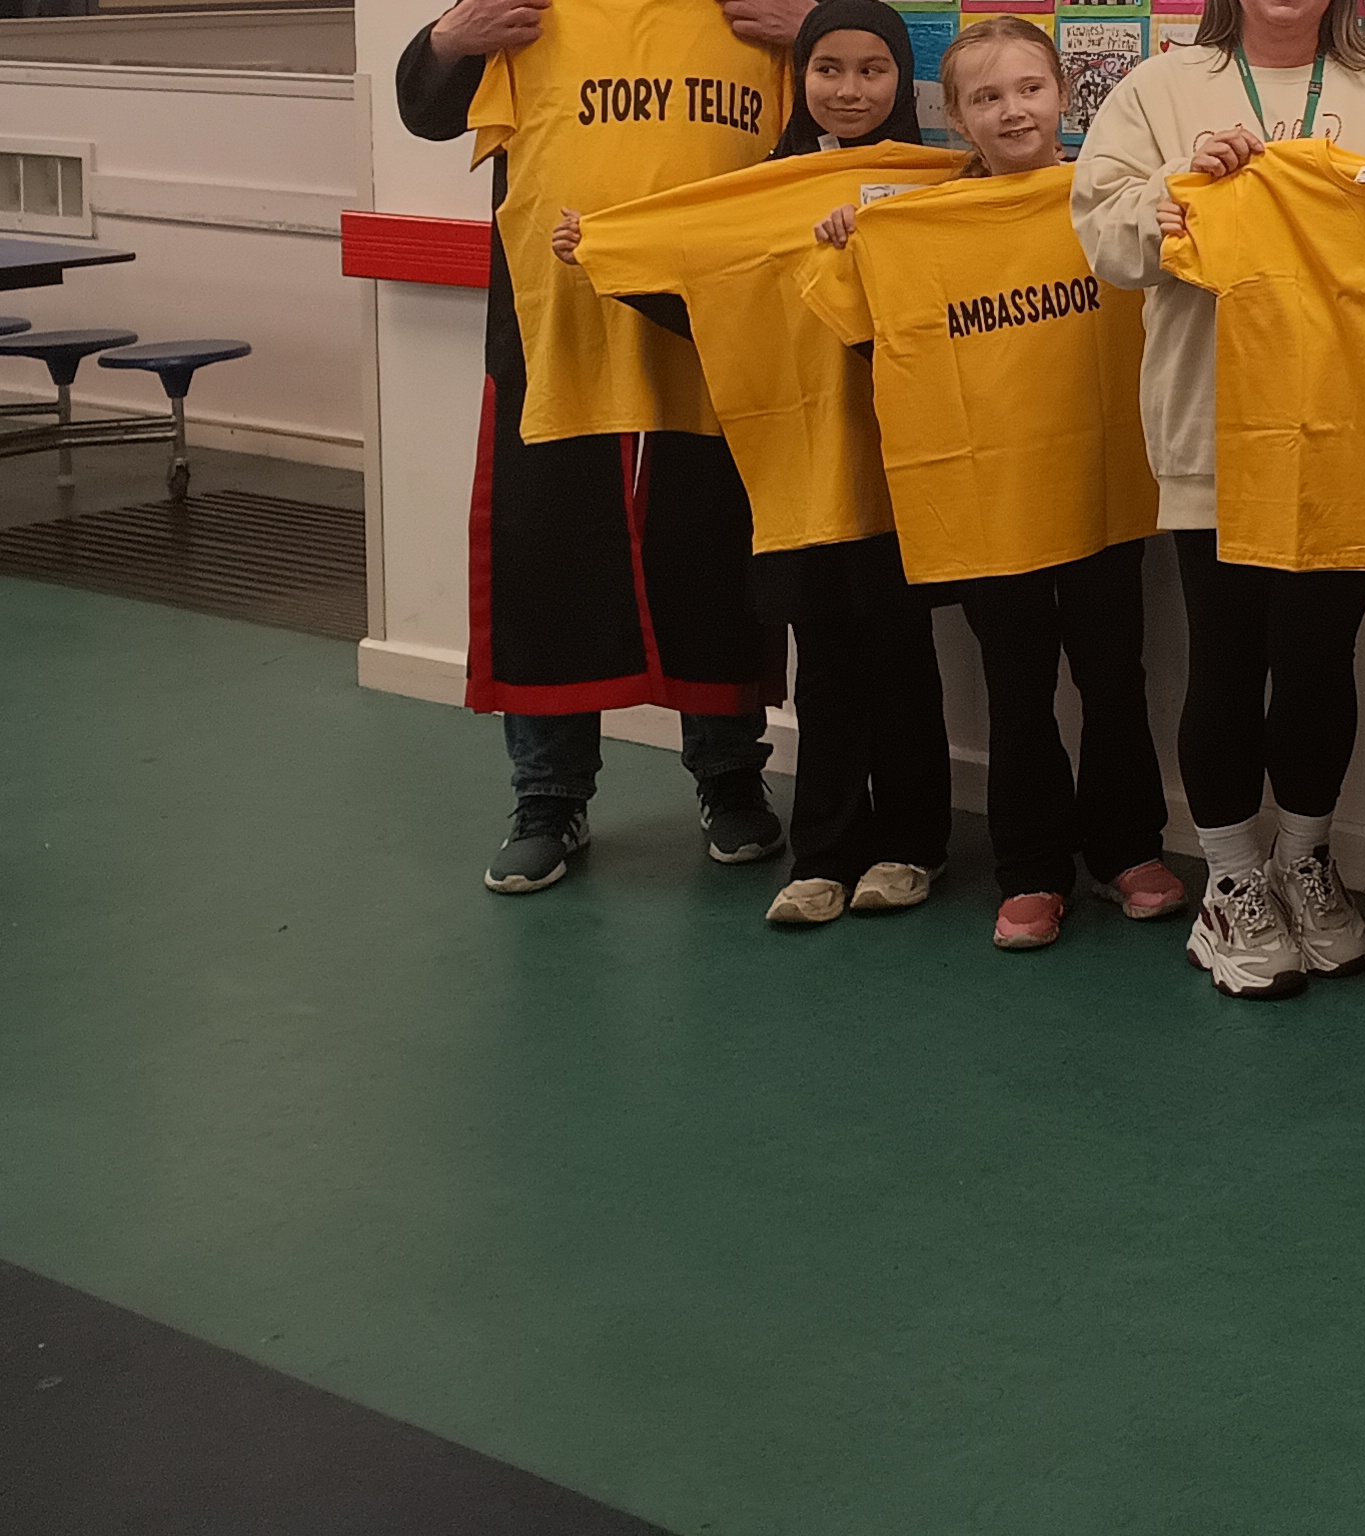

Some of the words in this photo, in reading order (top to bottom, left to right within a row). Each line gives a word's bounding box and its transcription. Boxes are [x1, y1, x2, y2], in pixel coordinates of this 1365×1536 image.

[579, 78, 672, 125] STORY
[686, 76, 763, 135] TELLER
[947, 274, 1101, 339] AMBASSADOR
